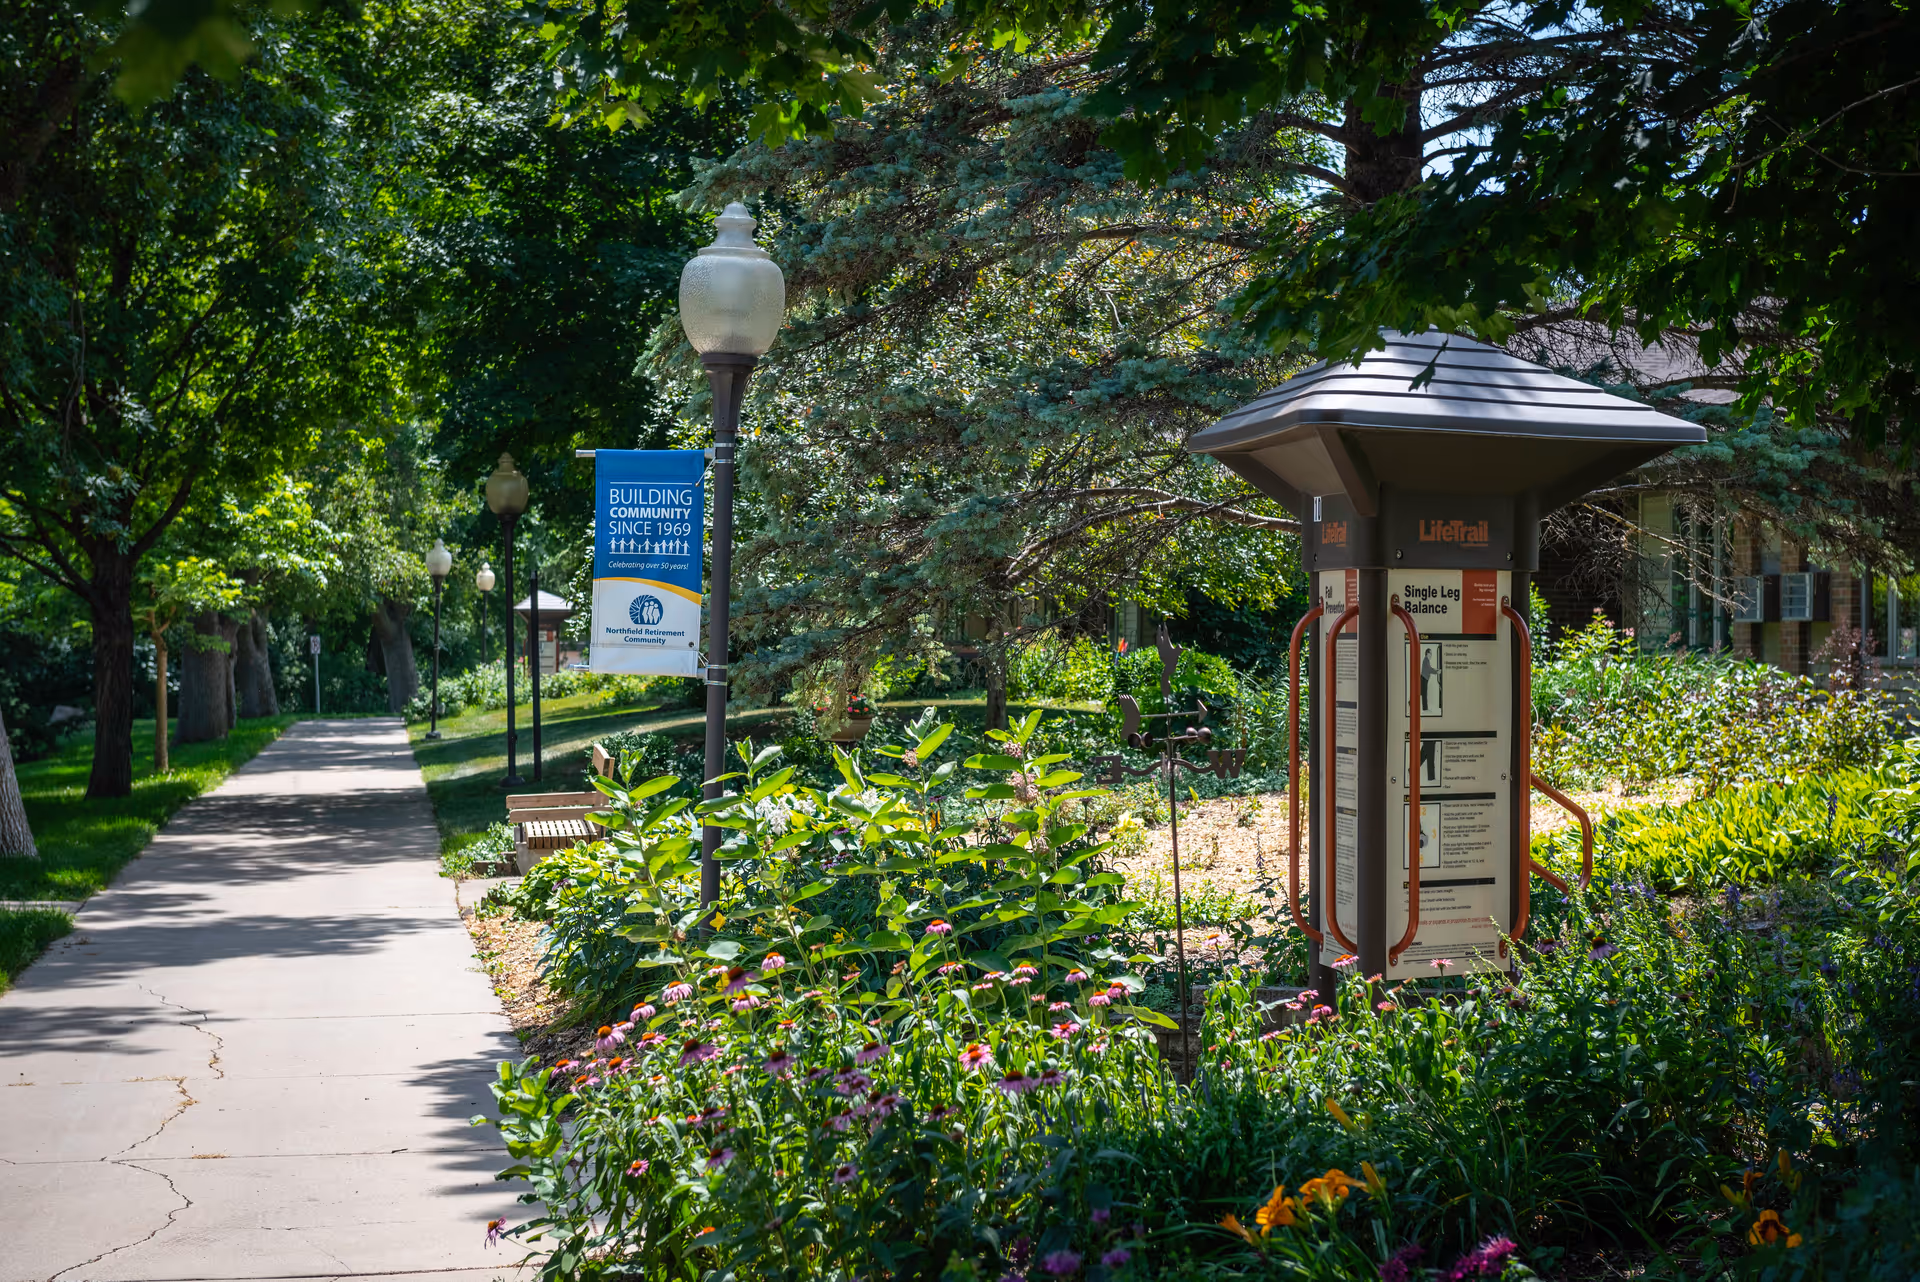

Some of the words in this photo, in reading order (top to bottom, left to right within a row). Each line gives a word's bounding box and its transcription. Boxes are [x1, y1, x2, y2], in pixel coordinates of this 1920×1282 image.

[609, 488, 693, 506] BUILDING
[609, 507, 692, 520] COMMUNITY
[608, 520, 652, 536] SINCE
[656, 521, 692, 537] 1969
[1419, 519, 1489, 542] LifeTrail
[608, 560, 645, 571] Celebrating
[645, 562, 660, 570] over
[660, 562, 670, 571] 50
[669, 563, 689, 571] years!
[1325, 585, 1333, 599] Fall
[1404, 584, 1438, 601] Single
[1440, 585, 1461, 602] Leg
[1325, 600, 1345, 615] Prevention
[1404, 600, 1448, 614] Balance
[605, 627, 643, 635] Northfield
[644, 628, 685, 637] Retirement
[623, 635, 667, 646] Community
